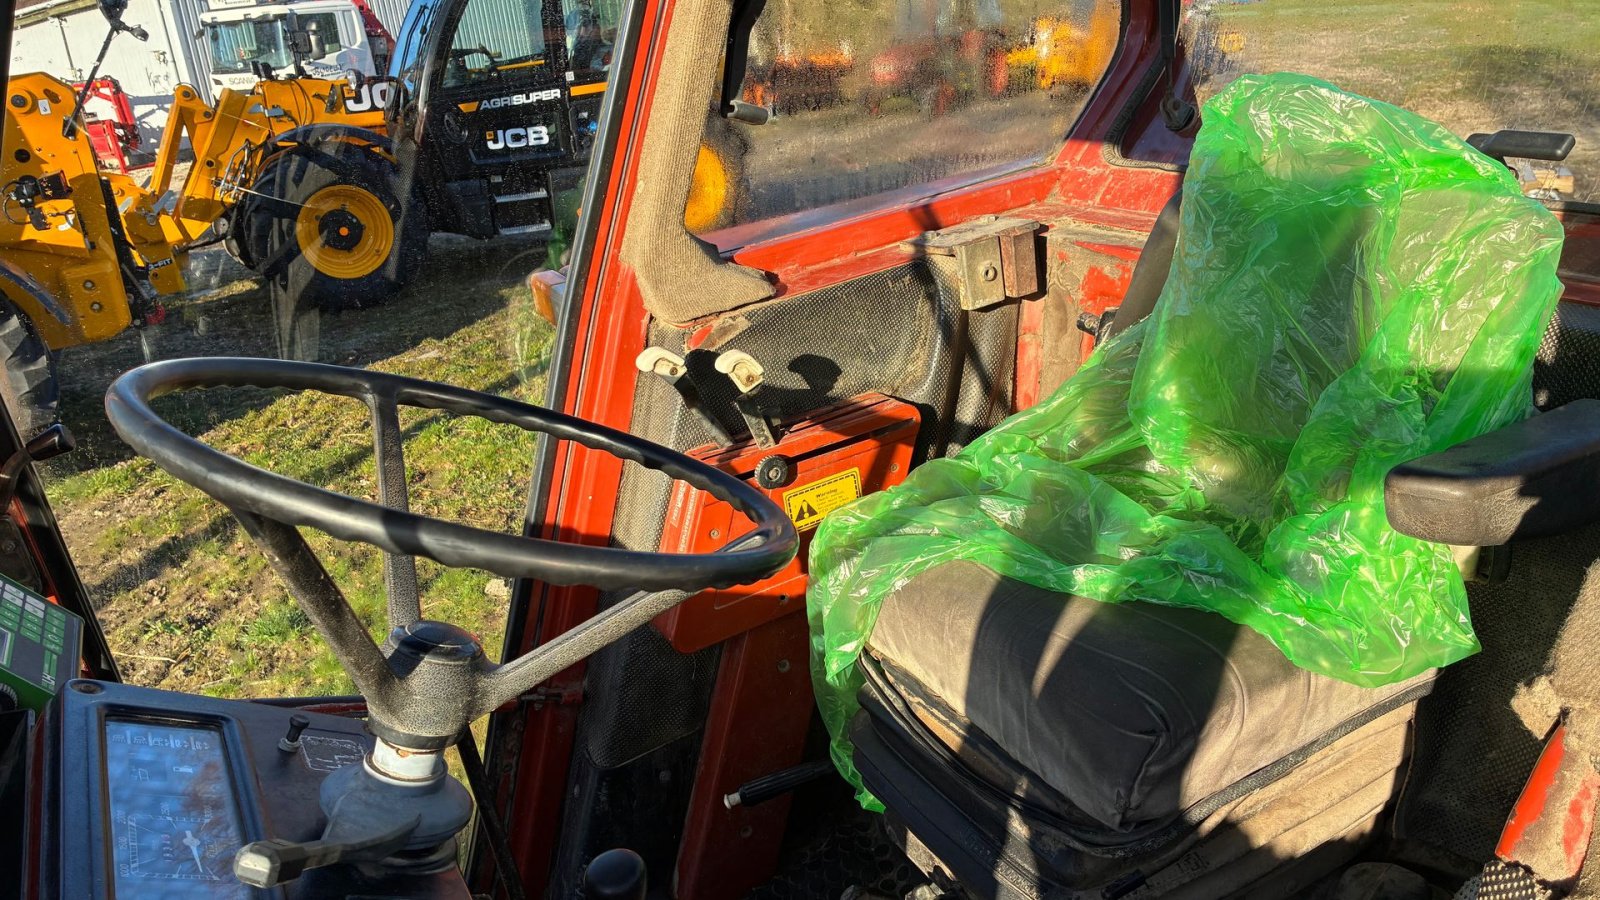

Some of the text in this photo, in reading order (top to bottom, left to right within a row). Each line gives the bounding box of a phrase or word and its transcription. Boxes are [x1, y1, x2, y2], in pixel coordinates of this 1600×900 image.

[229, 77, 255, 86] SCANIA
[480, 88, 561, 110] AGRISUPER
[486, 126, 549, 150] JCB
